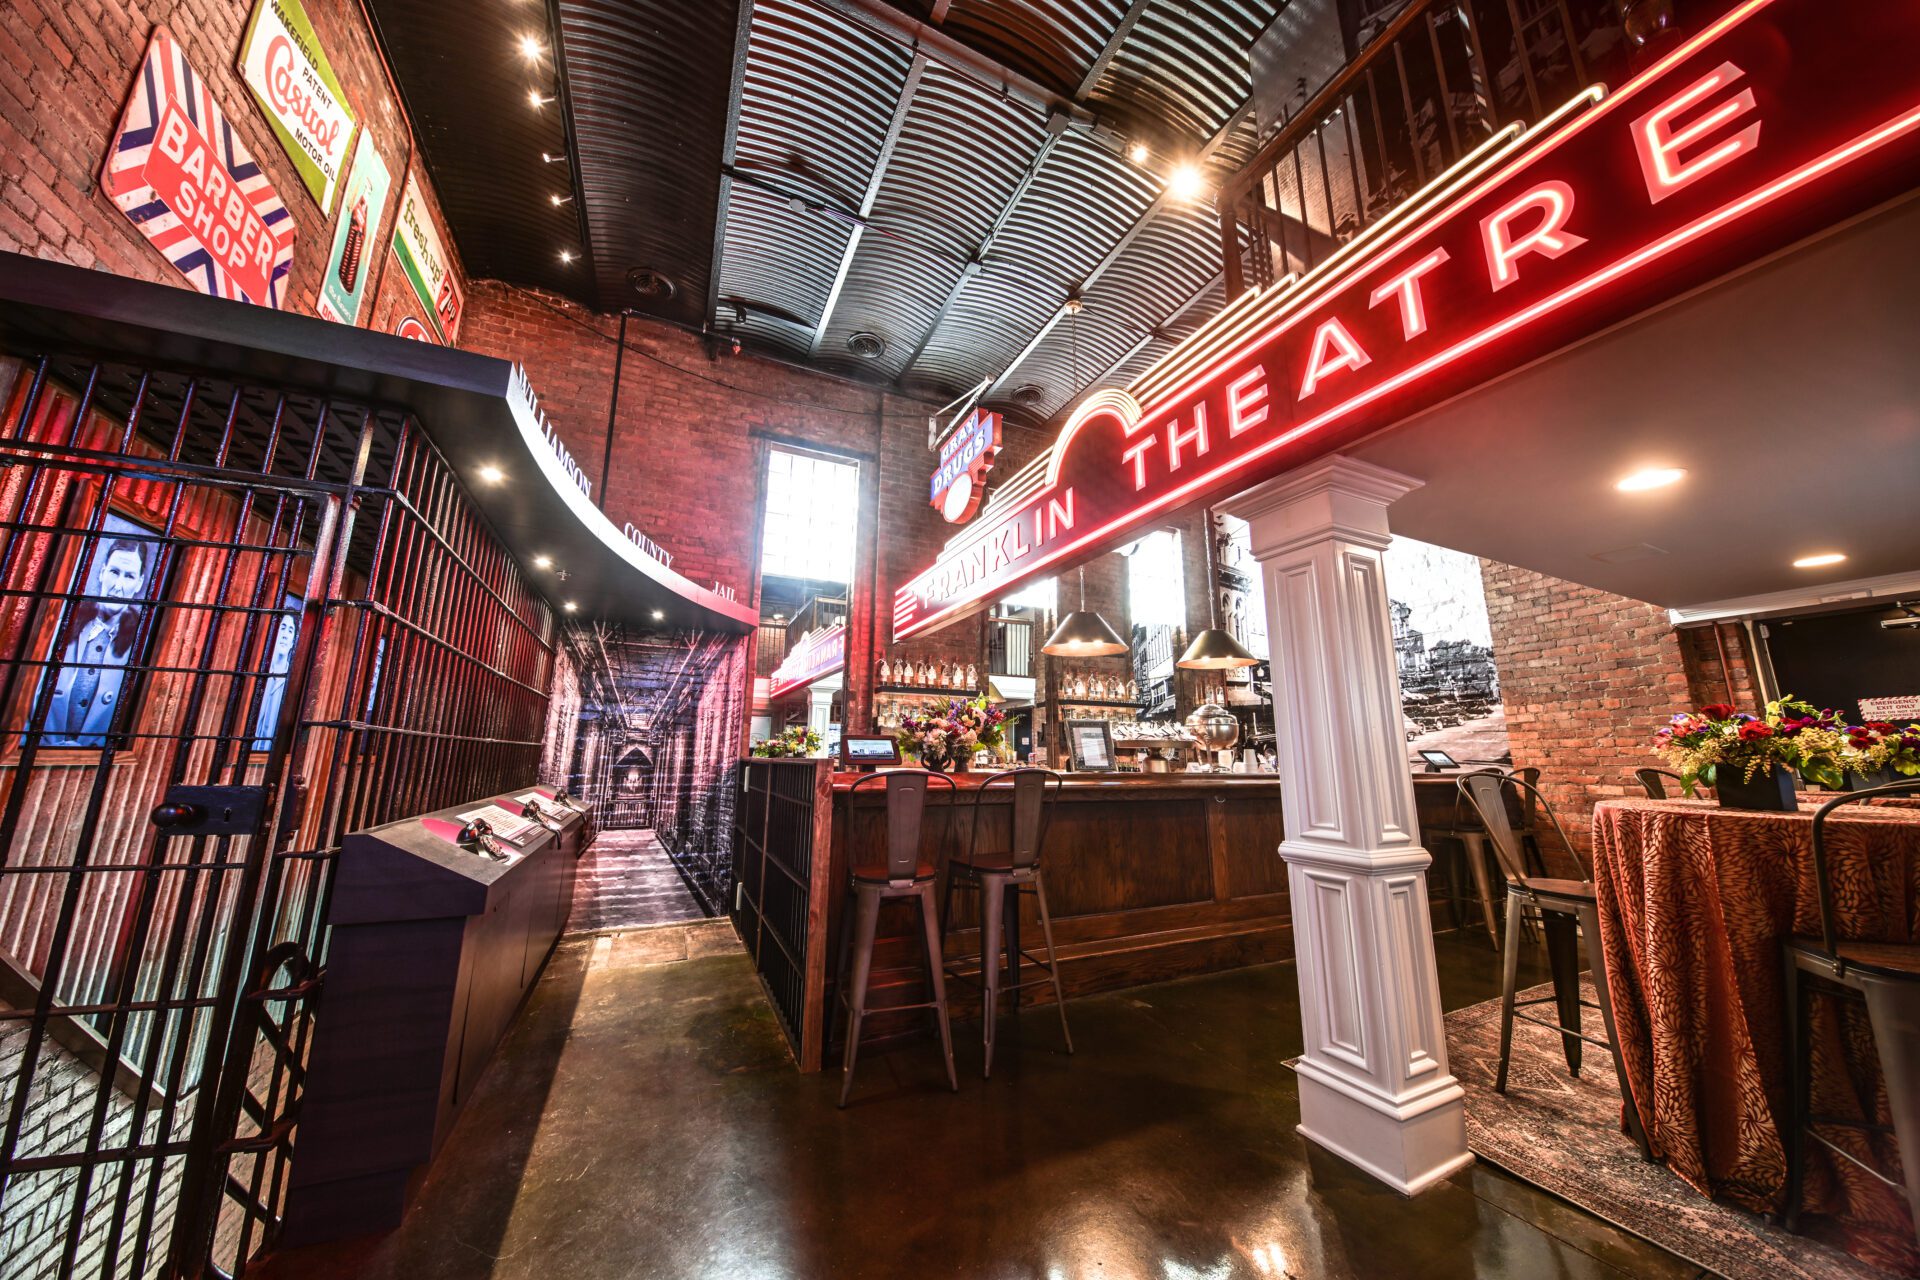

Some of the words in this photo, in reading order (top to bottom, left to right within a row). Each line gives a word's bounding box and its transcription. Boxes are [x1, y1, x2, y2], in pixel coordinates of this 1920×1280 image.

[270, 0, 319, 71] WAKEFIELD
[264, 35, 339, 156] Castrol
[302, 67, 333, 110] PATENT
[158, 108, 273, 281] BARBER
[295, 127, 323, 168] MOTOR
[324, 162, 335, 183] OIL
[175, 180, 247, 268] SHOP
[1122, 61, 1762, 491] THEATRE
[517, 360, 592, 499] WILLIAMSON
[934, 428, 985, 495] DRUGS
[942, 413, 977, 459] GRAY
[624, 522, 674, 570] COUNTY
[711, 581, 738, 604] JAIL
[923, 485, 1075, 610] FRANKLIN
